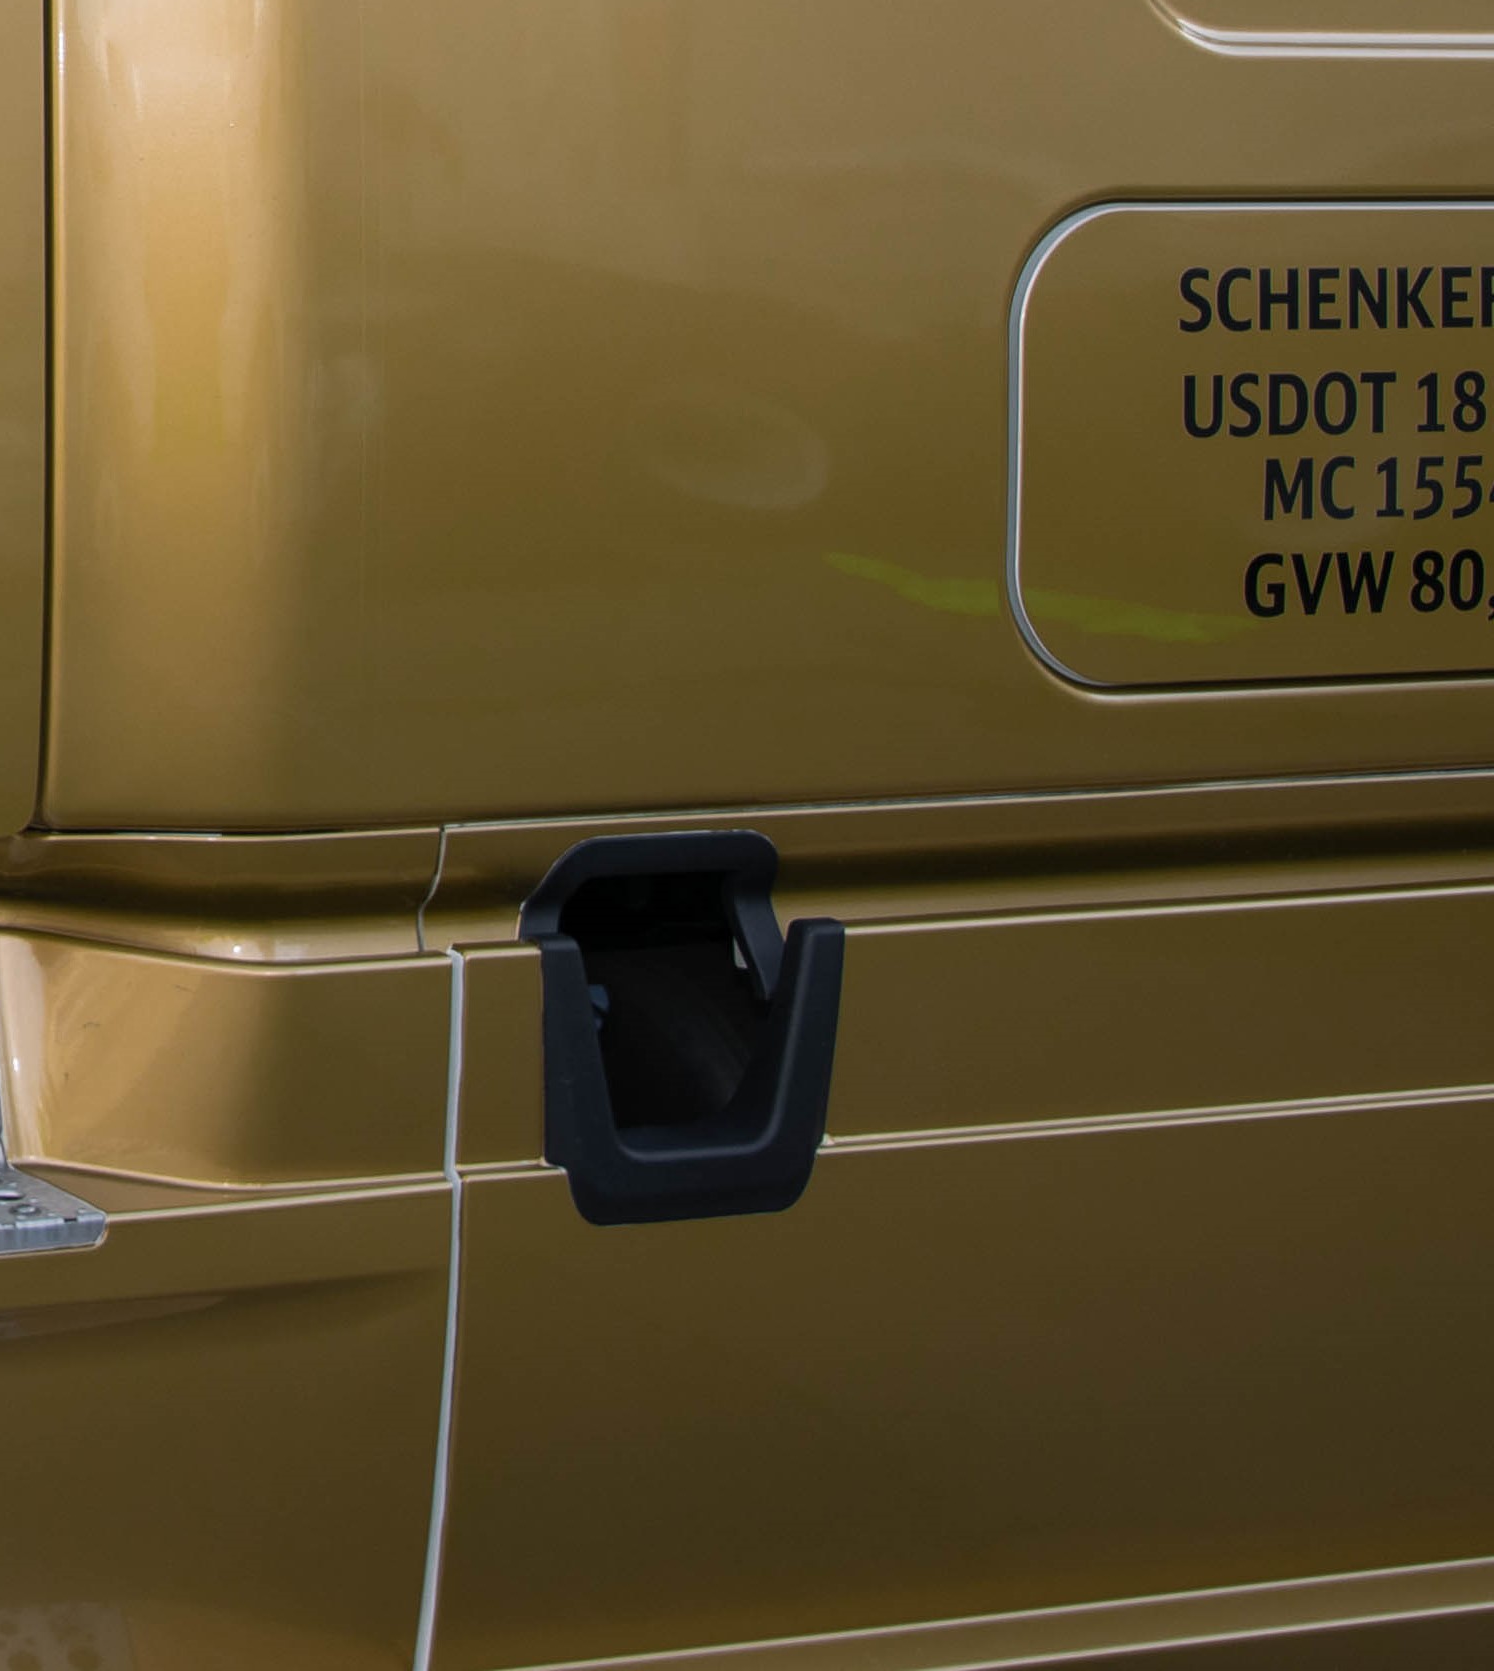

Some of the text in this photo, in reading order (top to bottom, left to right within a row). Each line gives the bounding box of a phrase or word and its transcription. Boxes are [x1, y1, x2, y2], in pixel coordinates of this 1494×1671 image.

[1183, 370, 1487, 437] USDOT 18
[1263, 455, 1494, 520] MC 155
[1243, 551, 1395, 617] GVW
